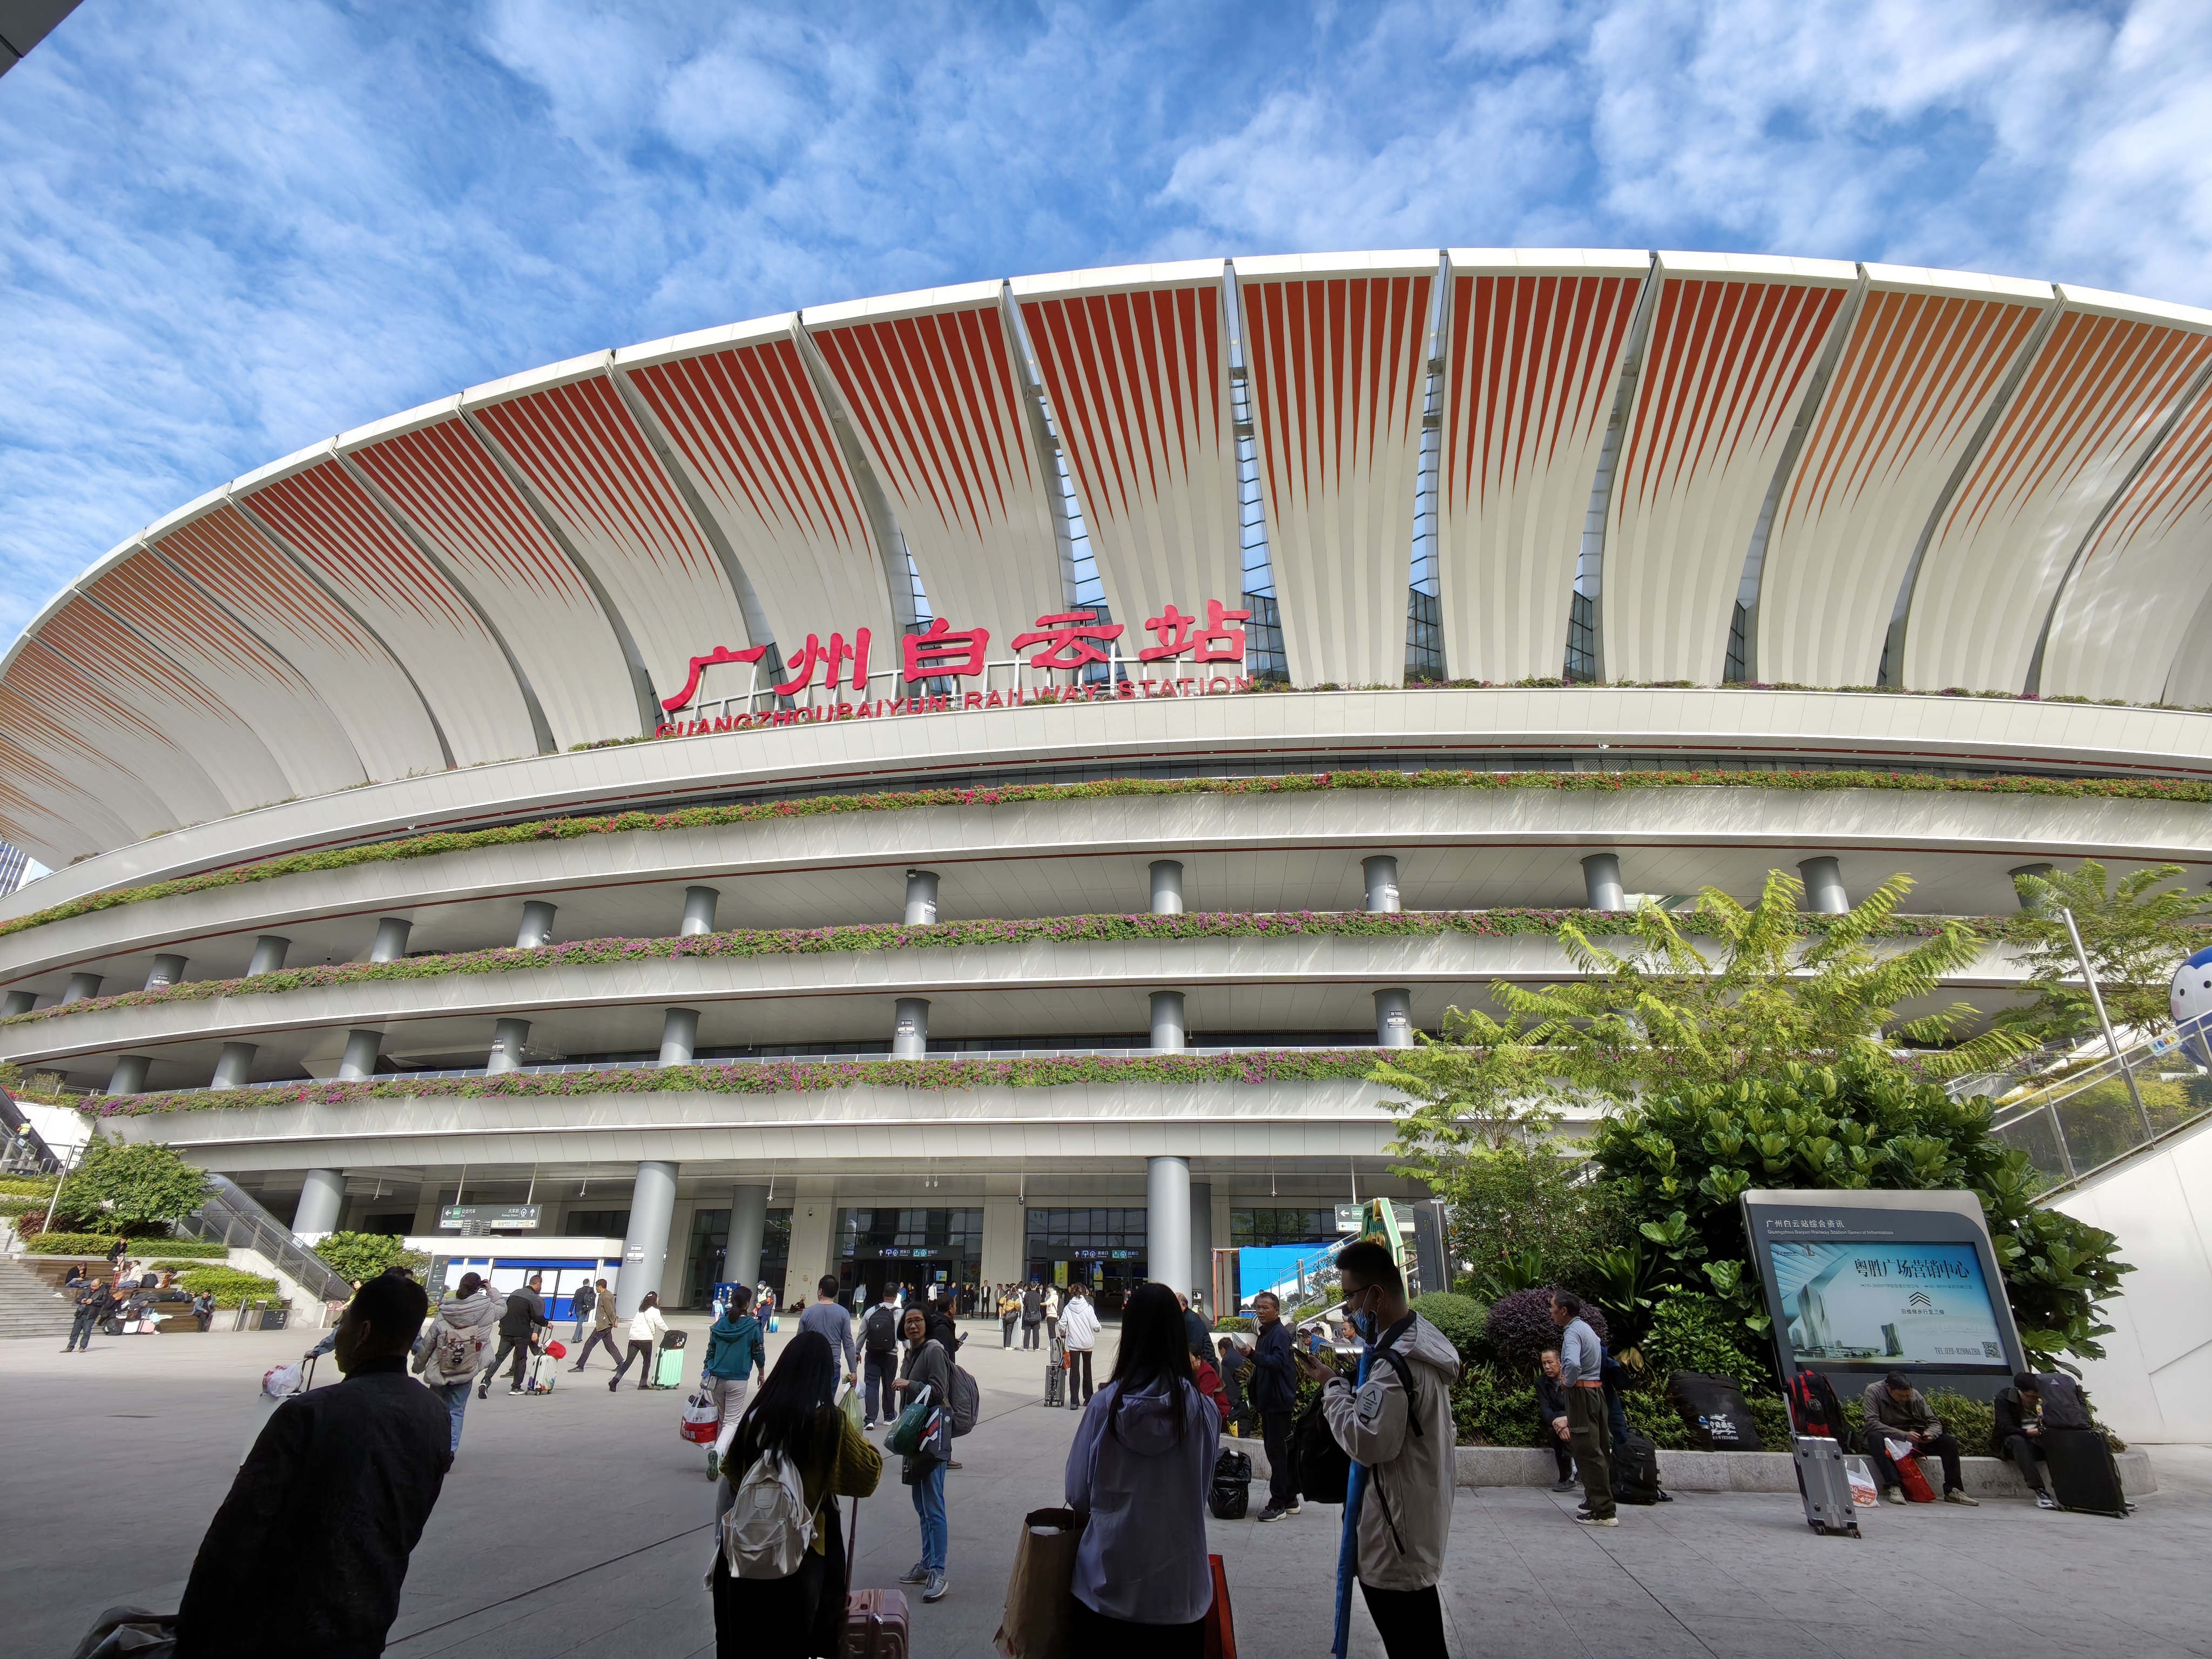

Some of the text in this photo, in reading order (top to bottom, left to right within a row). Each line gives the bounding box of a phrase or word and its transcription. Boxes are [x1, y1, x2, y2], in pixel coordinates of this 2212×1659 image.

[662, 598, 1251, 712] 广州白云站
[964, 682, 1101, 710] RAILWAY
[1117, 675, 1255, 700] STATION
[1766, 1219, 1844, 1228] 广州白云站综合资讯
[1854, 1258, 1970, 1279] 粤胜广场营销中心
